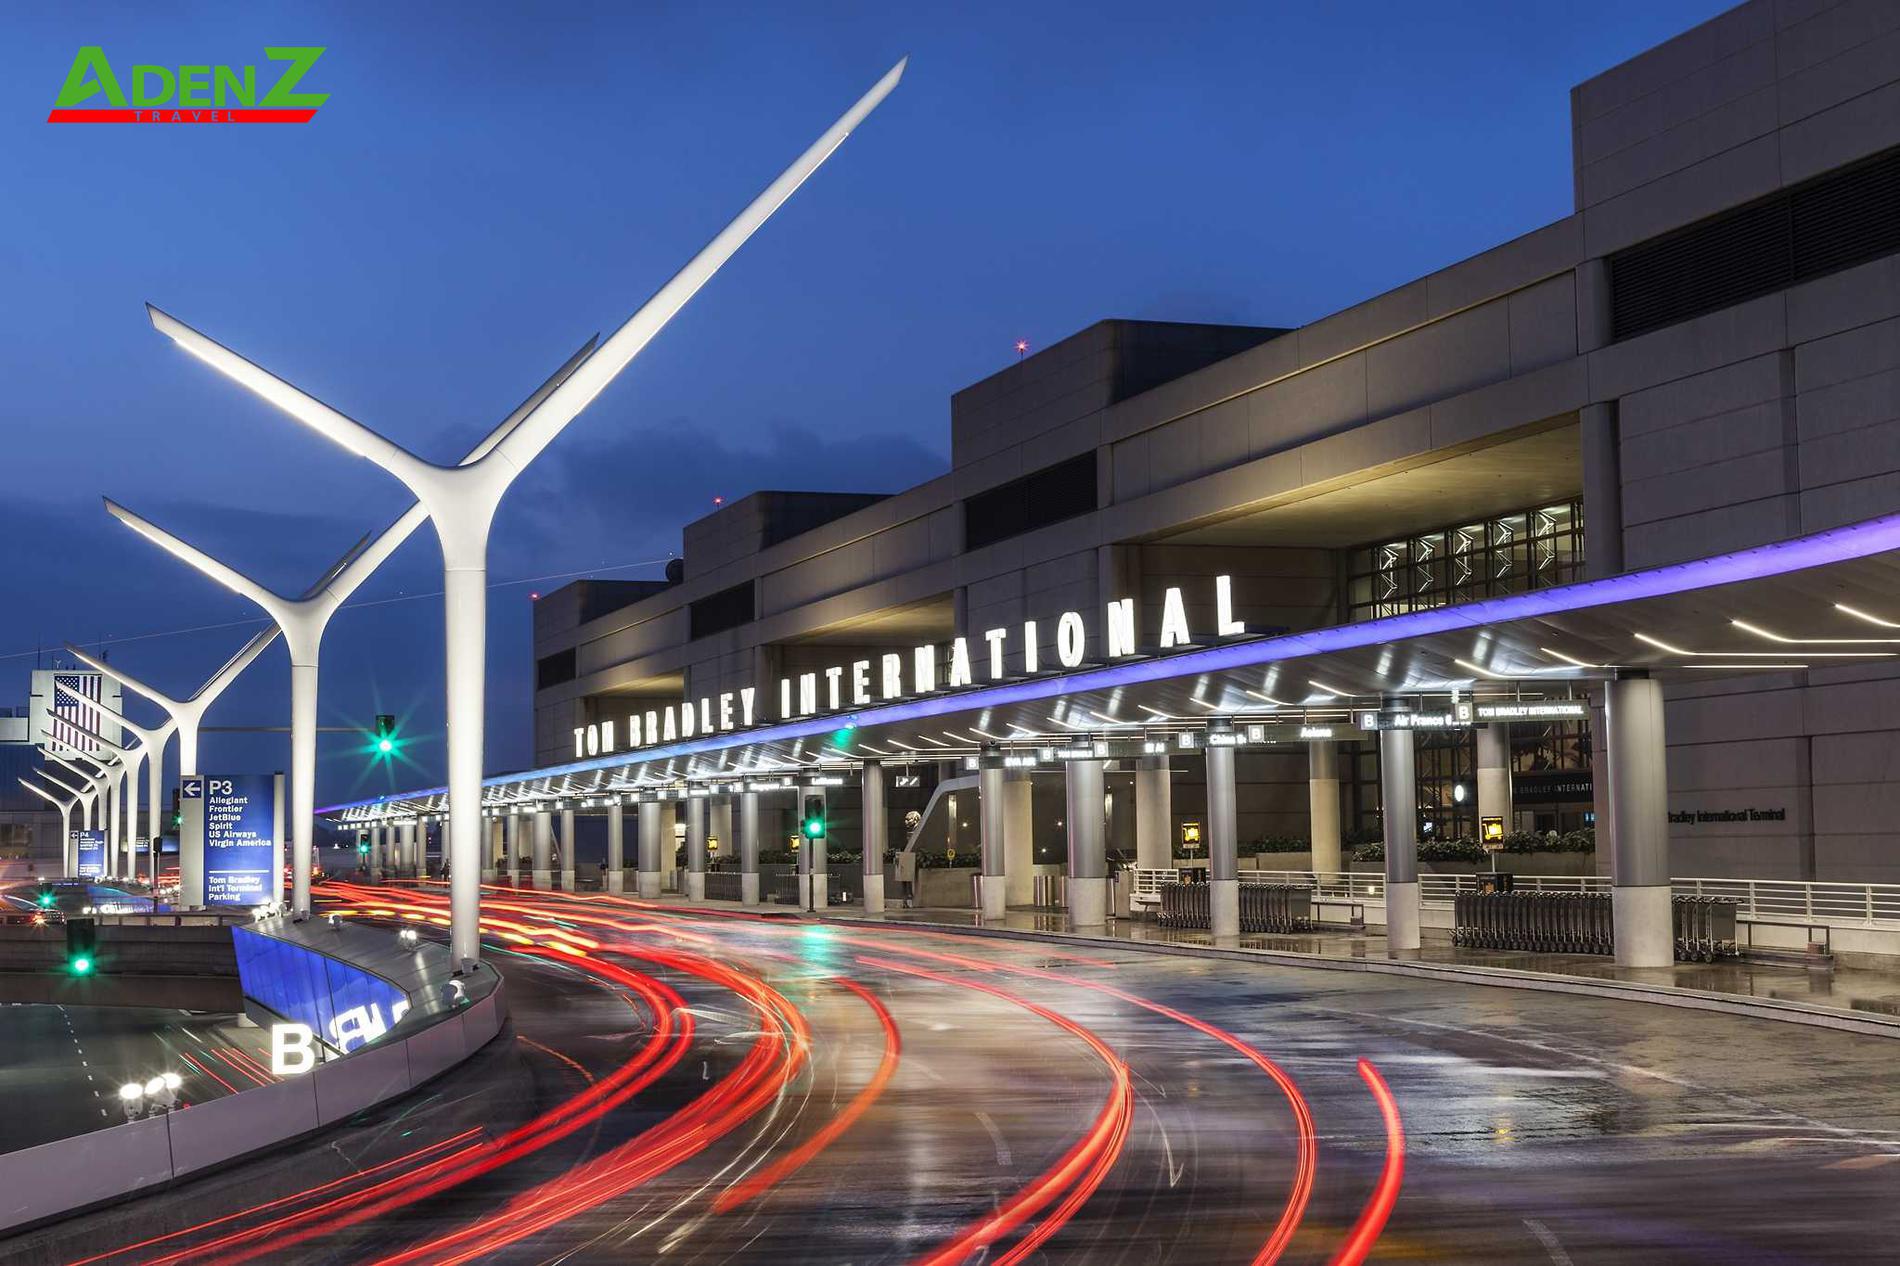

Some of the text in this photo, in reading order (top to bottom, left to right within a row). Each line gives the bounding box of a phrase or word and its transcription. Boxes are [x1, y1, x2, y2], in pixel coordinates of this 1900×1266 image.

[574, 575, 1245, 758] TOM BRADLEY INTERNATIONAL
[1478, 707, 1494, 717] TOM
[1364, 714, 1374, 727] B
[1394, 714, 1409, 726] Air
[1411, 714, 1444, 726] France
[209, 780, 233, 795] P3
[1553, 782, 1593, 793] INTERNATI
[209, 797, 249, 805] Allegiant
[209, 805, 243, 813] Frontier
[209, 822, 233, 830] Spirit
[209, 830, 257, 839] US Airways
[209, 839, 272, 848] Virgin America
[209, 876, 261, 885] Tom Bradley
[227, 884, 263, 892] Terminal
[208, 893, 241, 901] Parking
[271, 1023, 315, 1075] B
